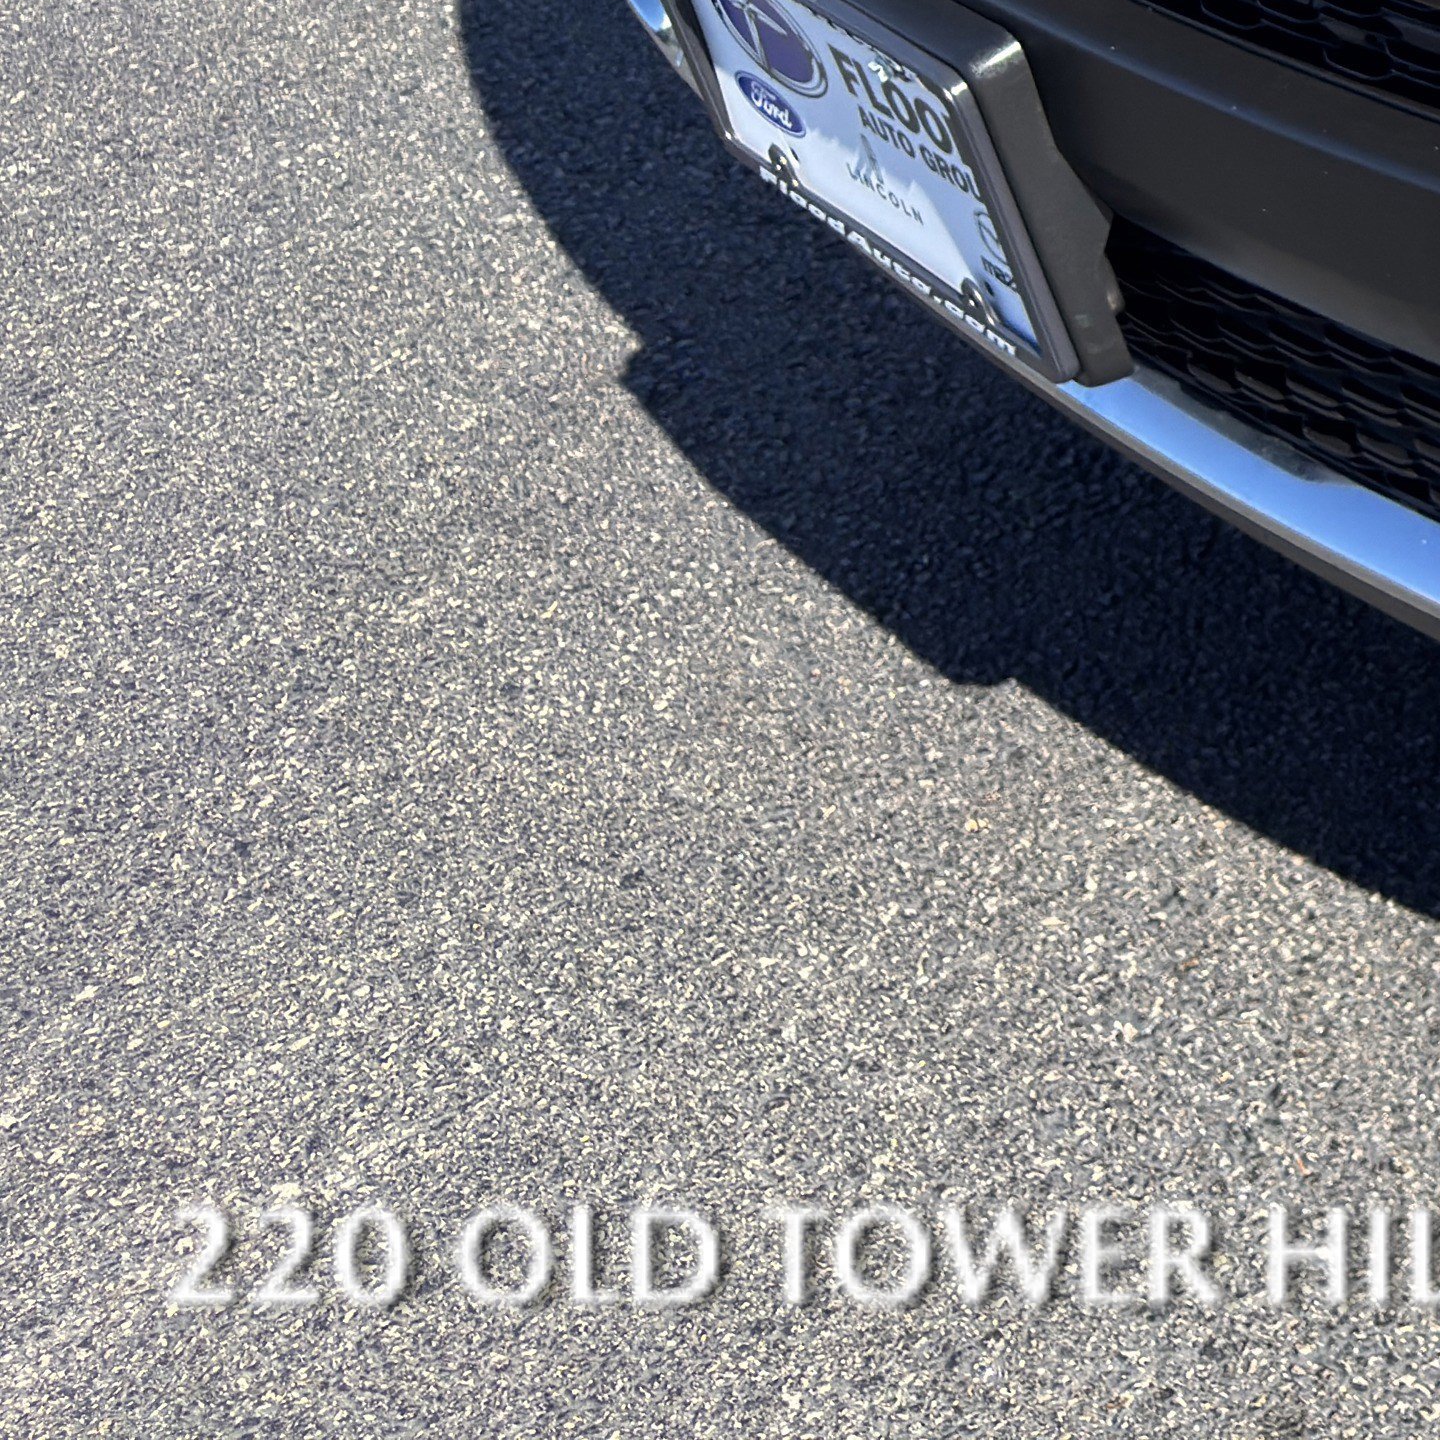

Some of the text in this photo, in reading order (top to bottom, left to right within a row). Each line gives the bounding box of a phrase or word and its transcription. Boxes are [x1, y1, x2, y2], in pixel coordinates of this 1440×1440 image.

[748, 80, 793, 129] Ford
[828, 42, 956, 155] FLOO
[846, 161, 924, 226] LINCOLN
[858, 104, 981, 200] AUTO GROU
[759, 165, 1017, 356] FloodAuto.com
